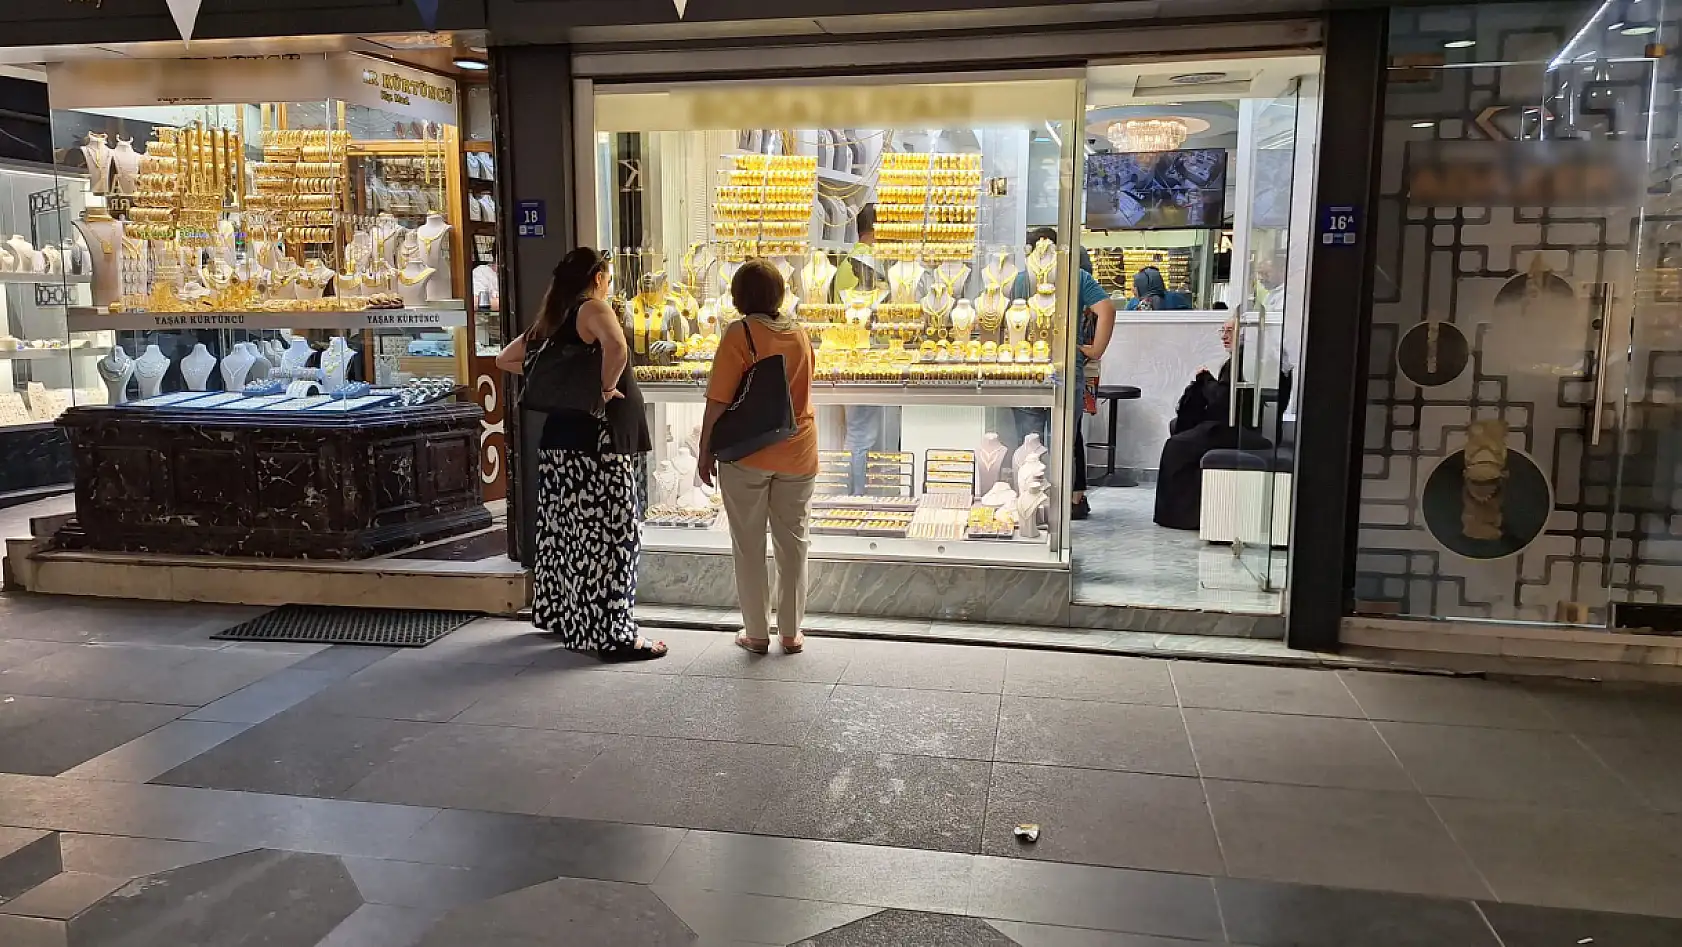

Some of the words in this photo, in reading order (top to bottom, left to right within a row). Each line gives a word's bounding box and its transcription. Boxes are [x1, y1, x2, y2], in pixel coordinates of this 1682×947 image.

[382, 72, 453, 104] KÜRTÜNCÜ
[154, 315, 187, 326] YAŞAR
[190, 314, 244, 324] KÜRTÜNCÜ
[367, 315, 395, 325] YAŞAR
[396, 313, 440, 324] KÜRTÜNCÜ
